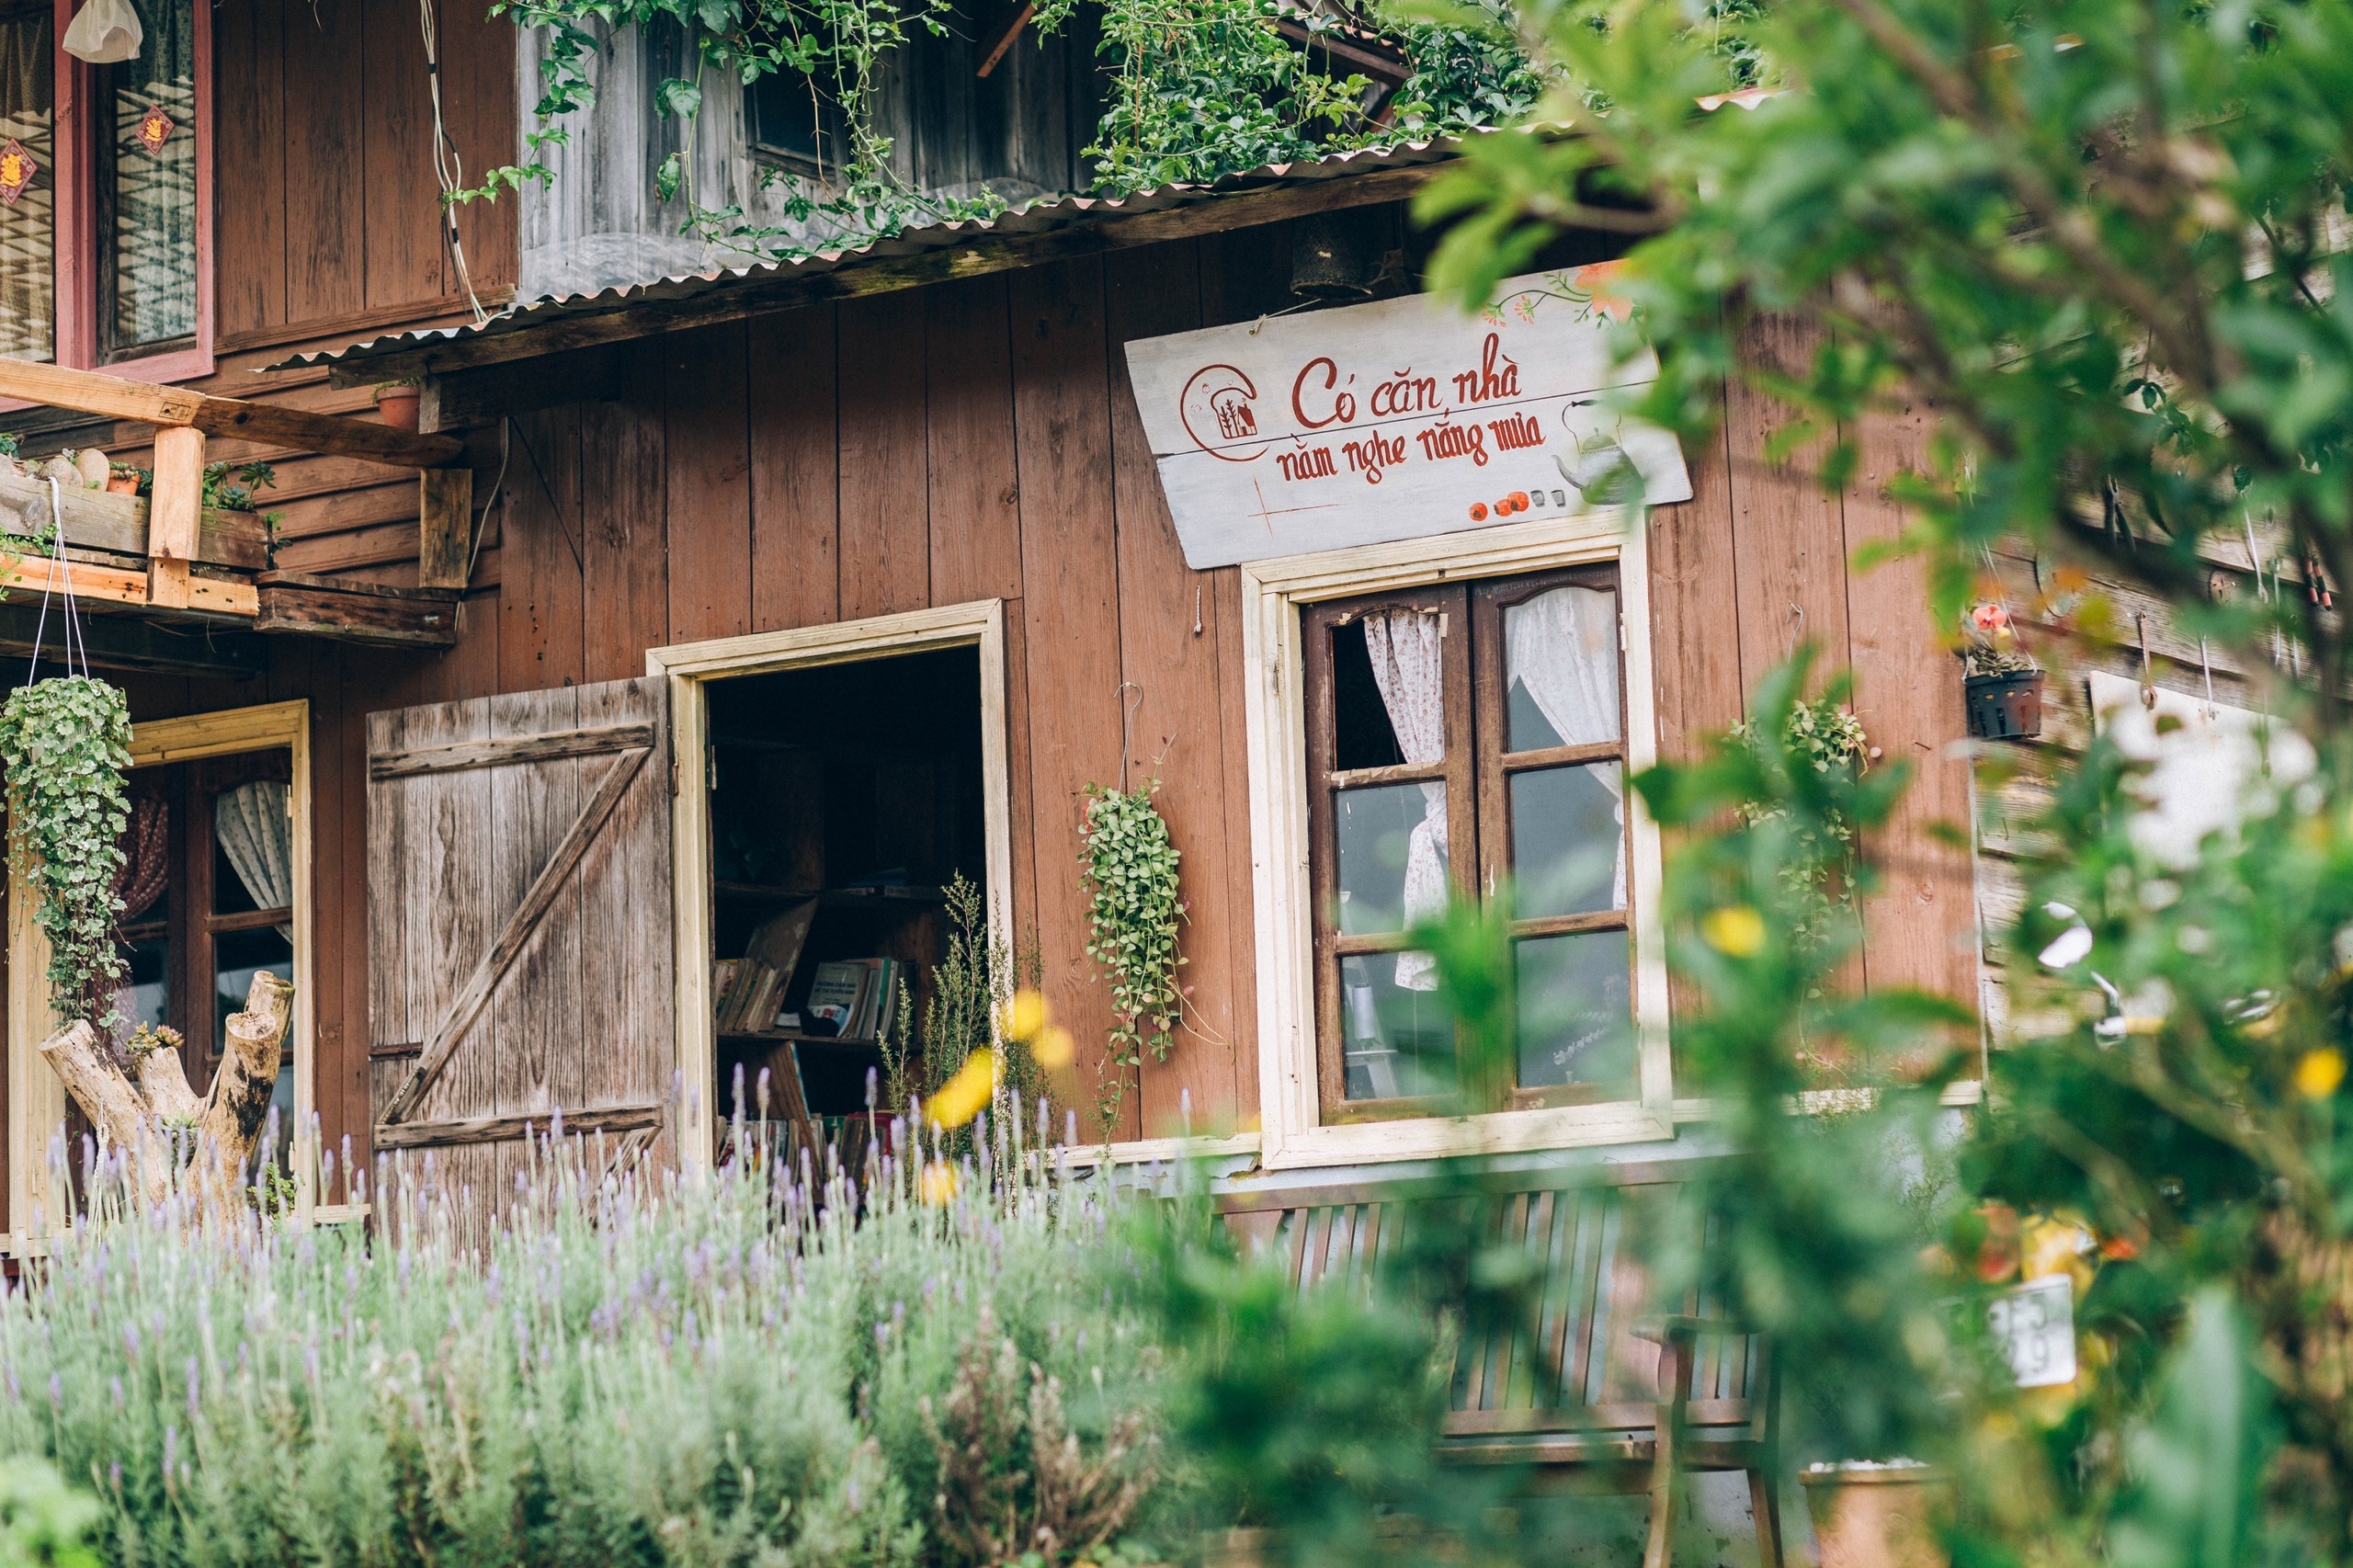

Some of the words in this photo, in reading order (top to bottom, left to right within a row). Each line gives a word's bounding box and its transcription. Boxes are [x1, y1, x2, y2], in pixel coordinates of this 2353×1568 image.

[1291, 357, 1356, 429] Có
[1370, 366, 1443, 416] căn
[1452, 332, 1522, 403] nhà
[1276, 433, 1338, 481] nằm
[1342, 429, 1407, 484] nghe
[1416, 407, 1488, 467] nắng
